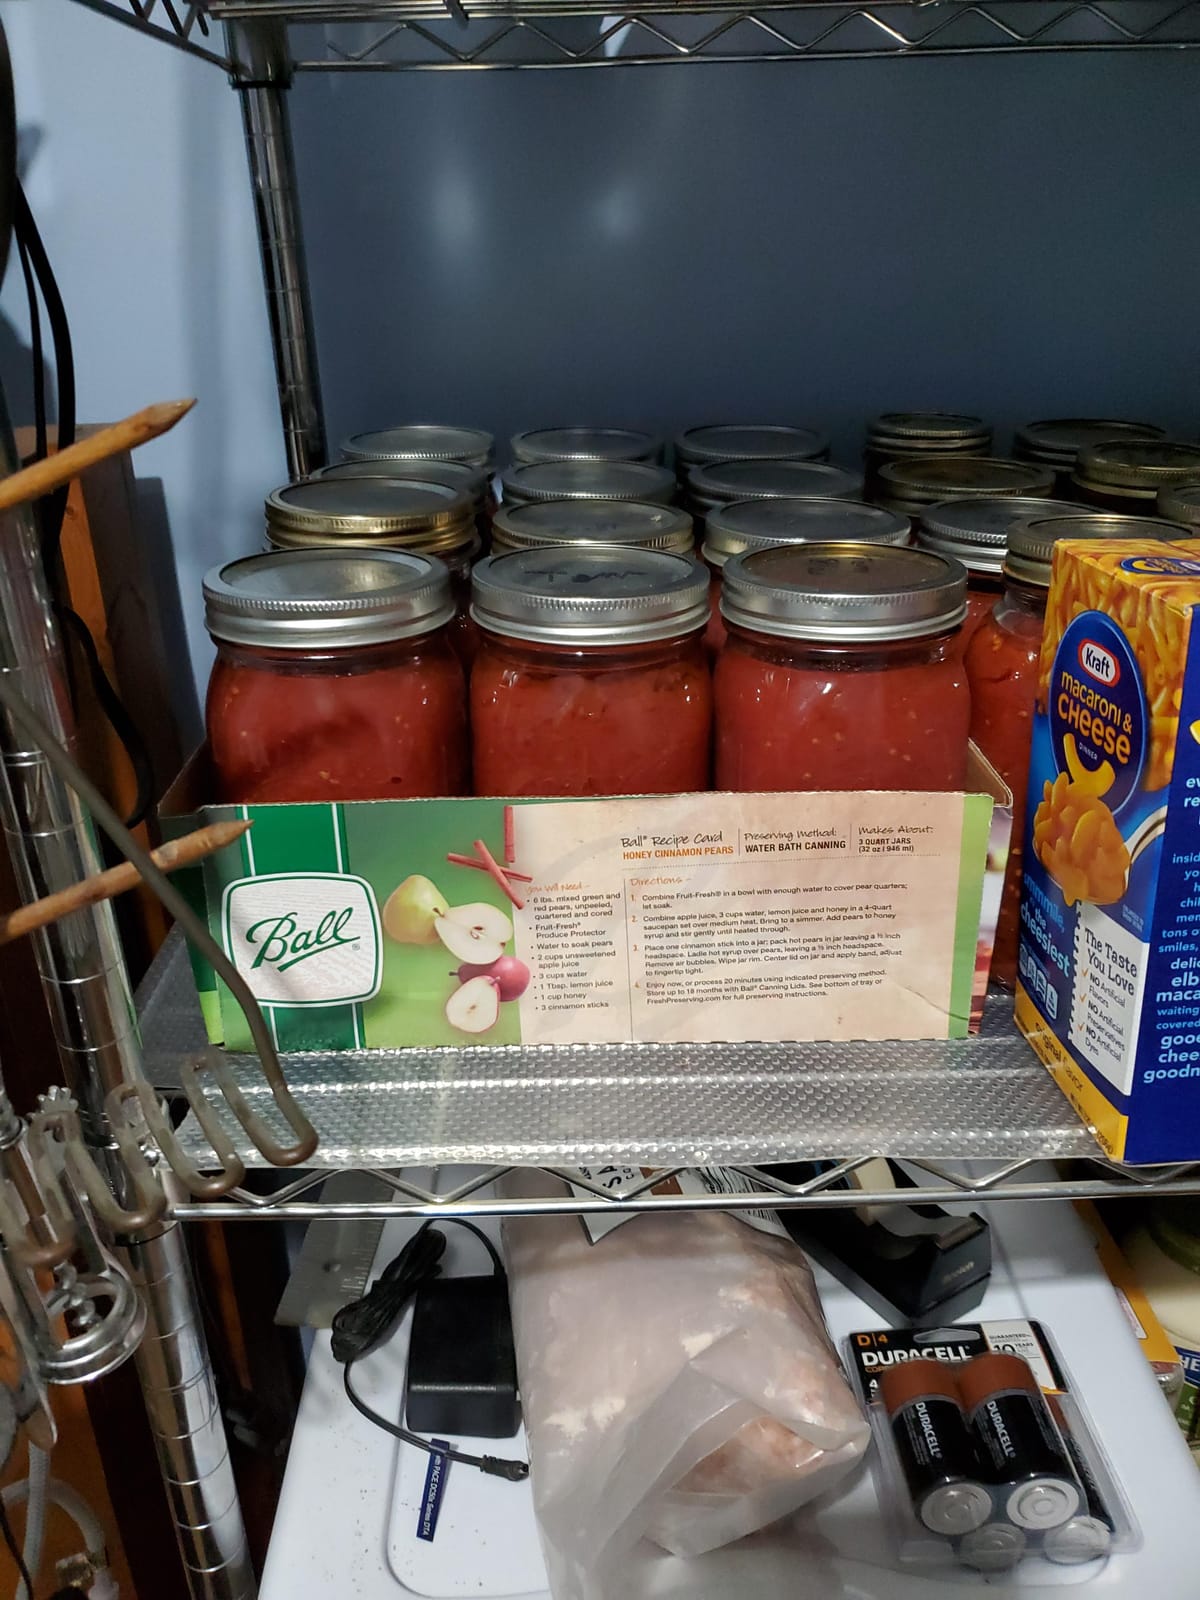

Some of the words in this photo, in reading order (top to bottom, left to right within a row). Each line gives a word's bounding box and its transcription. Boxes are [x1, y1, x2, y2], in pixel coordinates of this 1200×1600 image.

[1086, 647, 1110, 678] Kraft
[1061, 671, 1121, 726] macaroni
[1123, 713, 1132, 734] &
[1079, 742, 1098, 760] DINNER
[744, 829, 793, 842] Preserving
[858, 826, 893, 835] Makes
[652, 834, 689, 848] Recipe
[694, 831, 723, 844] Card
[623, 850, 652, 860] HONEY
[655, 848, 702, 858] CINNAMON
[704, 846, 733, 855] PEARS
[745, 844, 775, 853] WATER
[779, 842, 801, 851] BATH
[804, 841, 846, 849] CANNING
[630, 876, 683, 886] Directions
[1184, 870, 1199, 880] yo
[562, 882, 582, 891] Need
[642, 894, 674, 902] Combine
[738, 888, 755, 896] bowl
[774, 887, 800, 895] enough
[643, 902, 651, 910] let
[535, 912, 572, 920] quartered
[643, 914, 675, 922] Combine
[677, 913, 697, 921] apple
[768, 908, 790, 916] lemon
[792, 907, 809, 915] juice
[1035, 907, 1046, 930] the
[644, 923, 678, 931] saucepan
[680, 921, 691, 929] set
[710, 919, 738, 927] medium
[760, 917, 779, 925] Bring
[644, 930, 663, 939] syrup
[665, 929, 679, 937] and
[681, 928, 692, 936] stir
[694, 927, 715, 937] gently
[717, 926, 732, 935] until
[734, 925, 758, 934] heated
[1162, 929, 1188, 938] tons
[245, 907, 360, 973] Ball
[1021, 901, 1070, 978] cheesiest
[1159, 941, 1199, 952] smiles,
[565, 950, 616, 959] unsweetened
[1085, 927, 1102, 953] The
[1105, 942, 1137, 978] Taste
[1087, 948, 1105, 975] You
[1108, 964, 1135, 995] Love
[595, 980, 613, 988] juice
[1171, 972, 1199, 987] elb
[547, 993, 561, 1001] cup
[1089, 985, 1109, 1008] Flavors
[1090, 972, 1100, 987] NO
[1100, 982, 1126, 1008] Artificial
[1156, 989, 1200, 1002] maca
[647, 996, 720, 1005] FreshPreserving.com
[746, 992, 783, 1000] preserving
[1088, 1000, 1099, 1014] NO
[1100, 1010, 1124, 1036] Artificial
[1157, 1006, 1199, 1016] waiting
[1156, 1018, 1200, 1029] covered
[1086, 1023, 1096, 1040] NO
[1098, 1035, 1122, 1062] Artificial
[1159, 1049, 1199, 1063] chee
[1144, 1064, 1200, 1083] goodn
[857, 1334, 871, 1346] D
[878, 1334, 888, 1343] 4
[861, 1346, 972, 1366] DURACELL
[915, 1401, 940, 1456] DURACELL
[987, 1400, 1014, 1456] DURACELL
